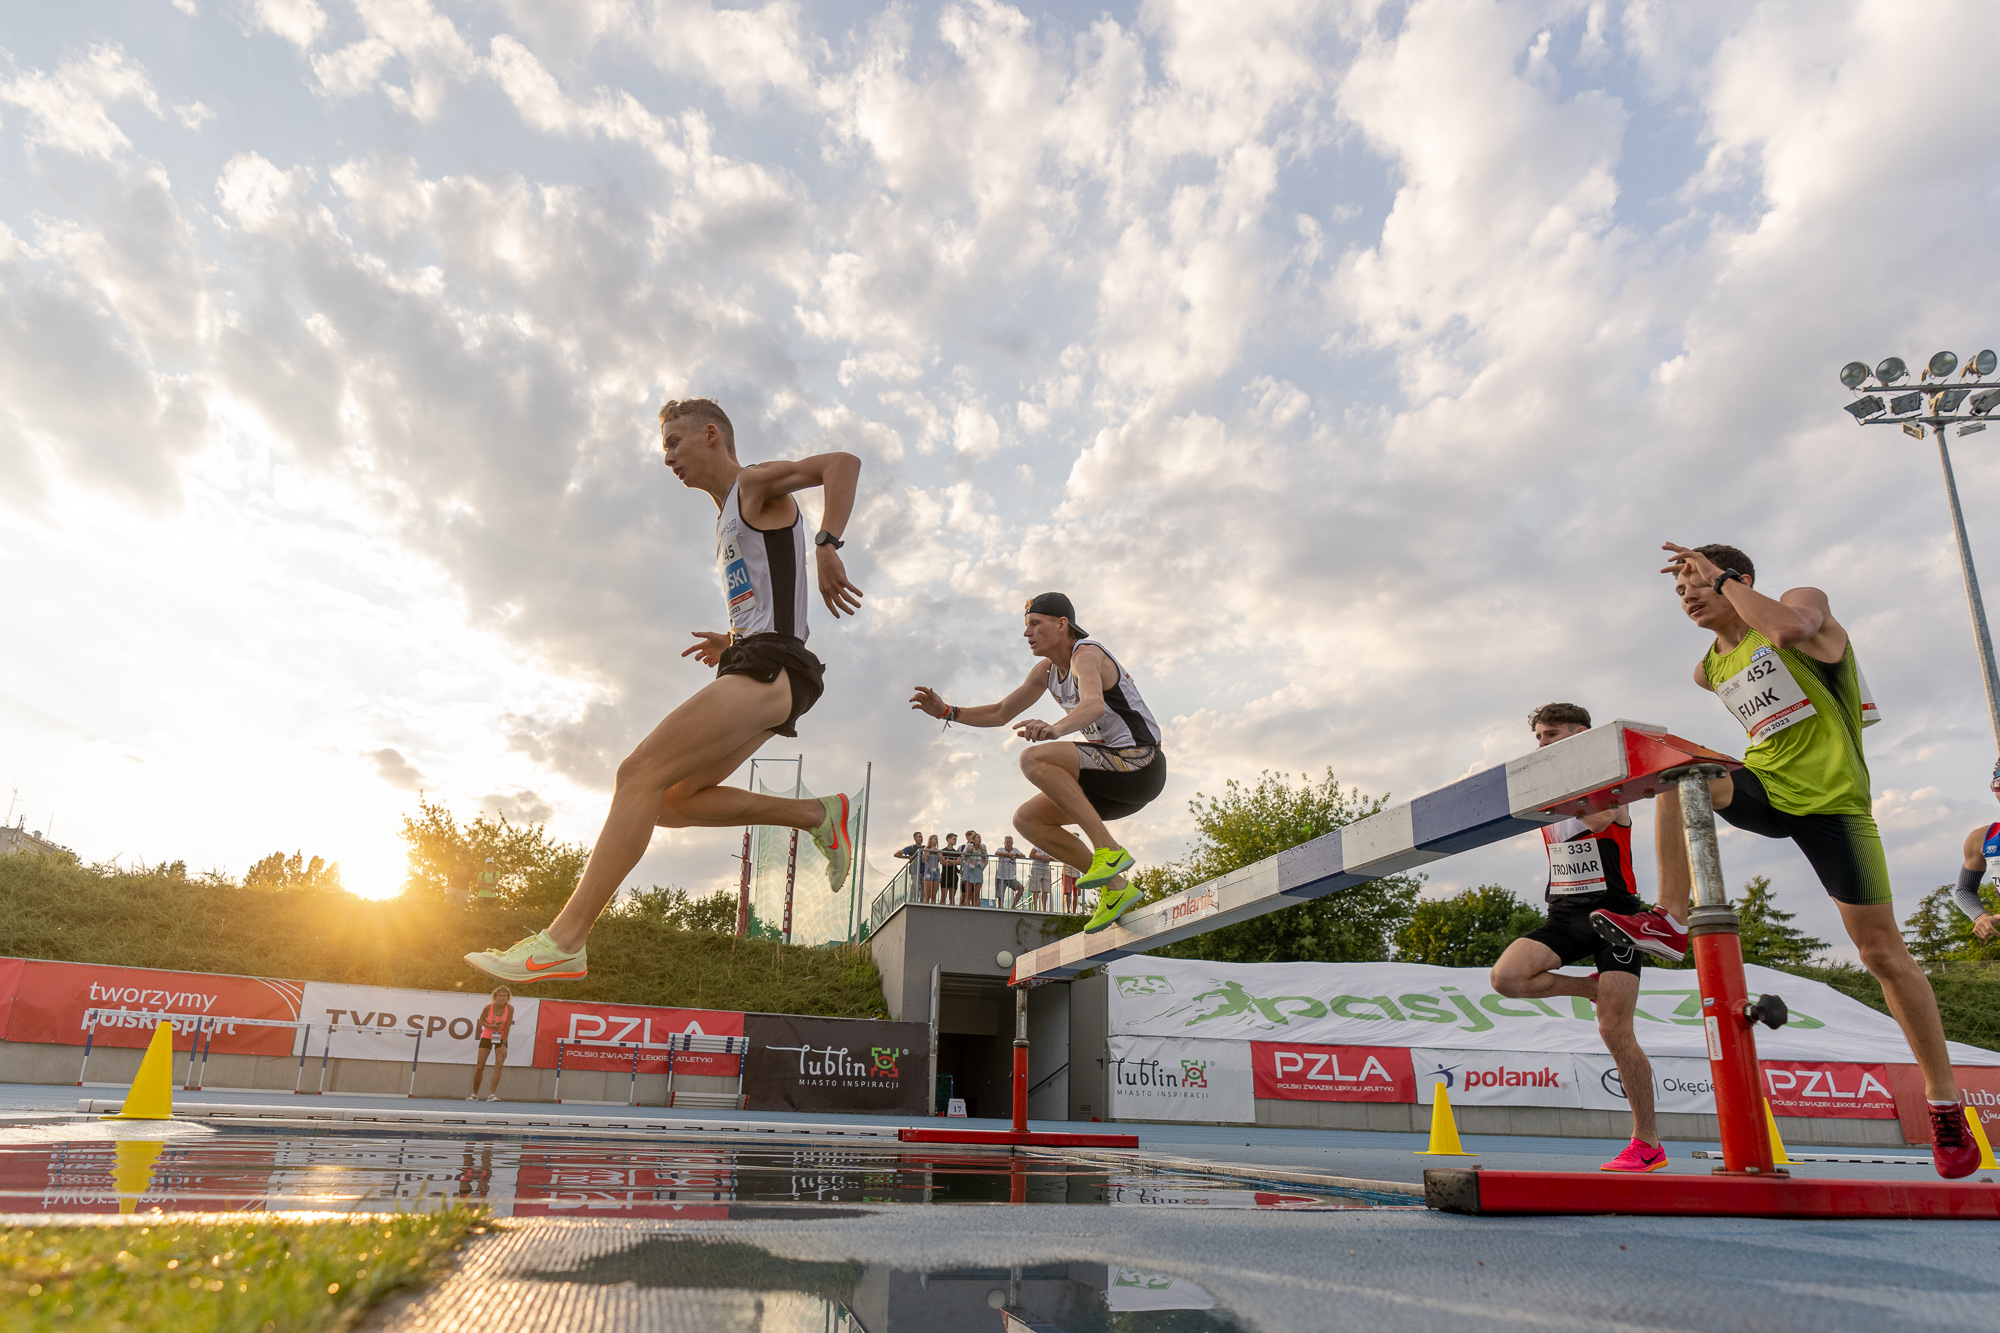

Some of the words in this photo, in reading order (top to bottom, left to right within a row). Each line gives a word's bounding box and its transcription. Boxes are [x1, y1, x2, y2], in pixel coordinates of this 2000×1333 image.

[1747, 660, 1777, 683] 452
[1738, 687, 1781, 720] FIJAK
[1770, 717, 1790, 730] 2023
[1567, 842, 1592, 855] 333
[1552, 860, 1600, 876] TROJNIAR
[1171, 888, 1215, 927] polanik
[89, 981, 218, 1013] tworzymy
[325, 1008, 397, 1035] TVP
[404, 1014, 515, 1041] SPO
[566, 1050, 598, 1059] POLSKI
[641, 1054, 671, 1062] LEKKIE
[675, 1055, 713, 1064] ATLETYKI
[1274, 1051, 1393, 1082] PZLA
[799, 1079, 837, 1087] MIASTO
[843, 1080, 899, 1089] INSPIRACJI
[1464, 1065, 1560, 1092] polanik
[1765, 1069, 1893, 1099] PZLA
[1116, 1089, 1152, 1097] MIASTO
[1157, 1090, 1209, 1099] INSPIRACJI
[953, 1105, 963, 1113] 17
